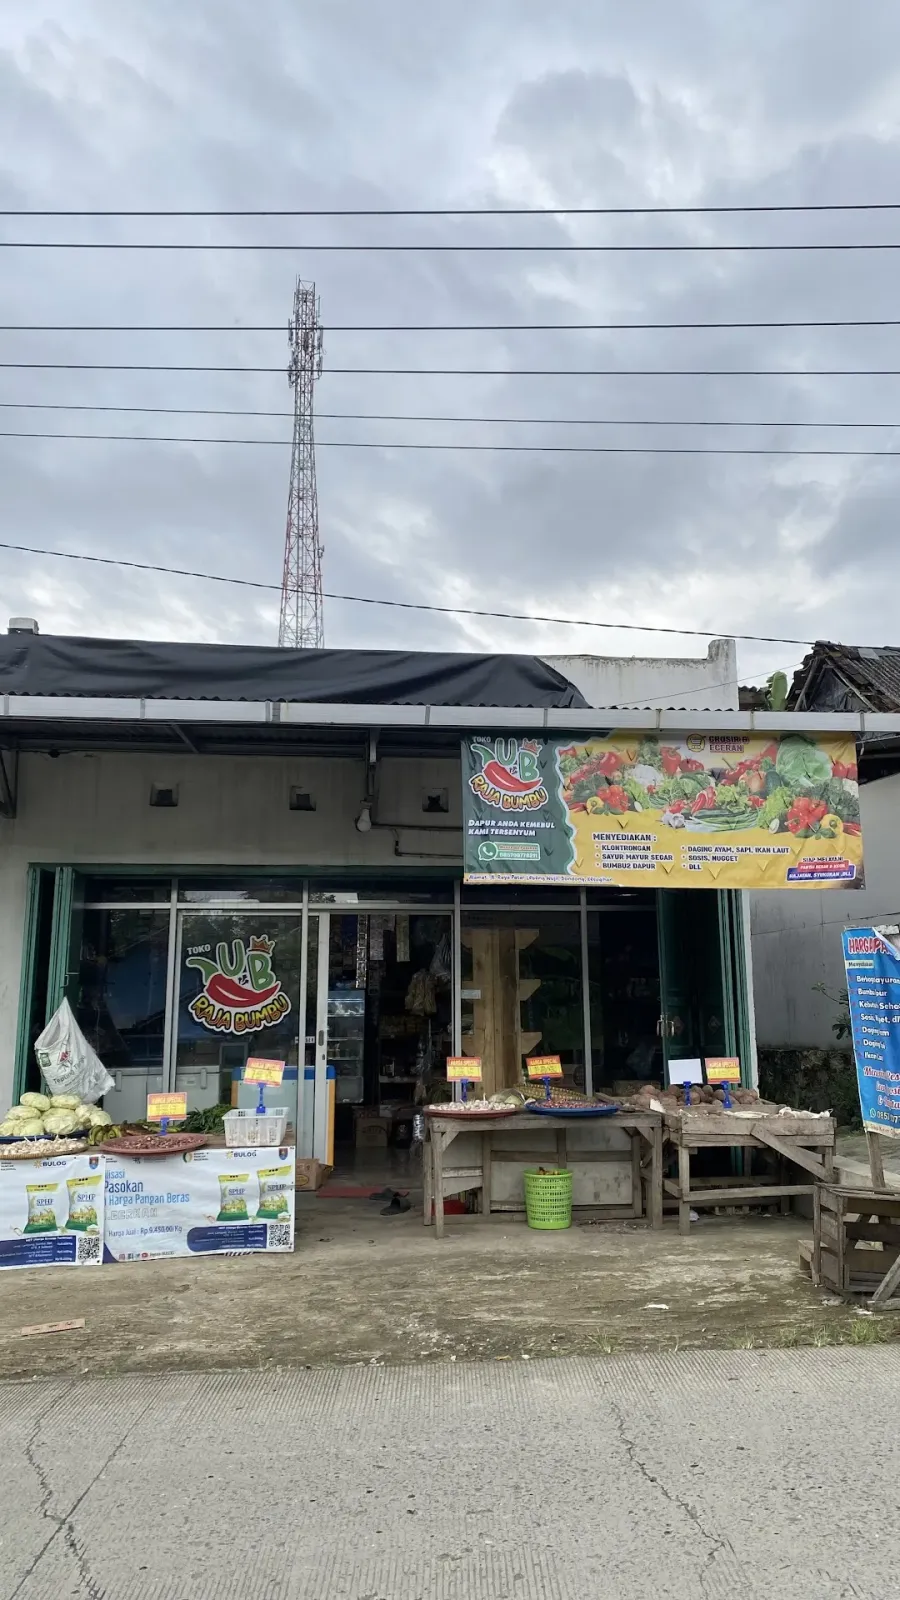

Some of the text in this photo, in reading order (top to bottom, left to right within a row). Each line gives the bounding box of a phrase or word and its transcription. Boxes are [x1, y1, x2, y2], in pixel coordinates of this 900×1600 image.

[710, 744, 742, 752] ECERAN
[471, 775, 501, 805] RAJA
[502, 788, 546, 809] BUMBU
[468, 819, 496, 827] DAPUR
[520, 821, 555, 829] KEMEBUL
[490, 828, 536, 836] TERSENYUM
[593, 833, 651, 841] MENYEDIAKAN
[601, 844, 651, 852] KLONTRONGAN
[714, 846, 734, 854] AYAM,
[187, 944, 211, 955] TOKO
[191, 995, 232, 1030] RAJA
[234, 994, 289, 1032] BUMBU
[105, 1180, 144, 1193] Pasokan
[109, 1195, 133, 1206] Harga
[135, 1193, 165, 1205] Pangan
[167, 1192, 190, 1203] Beras
[108, 1229, 125, 1238] Harga
